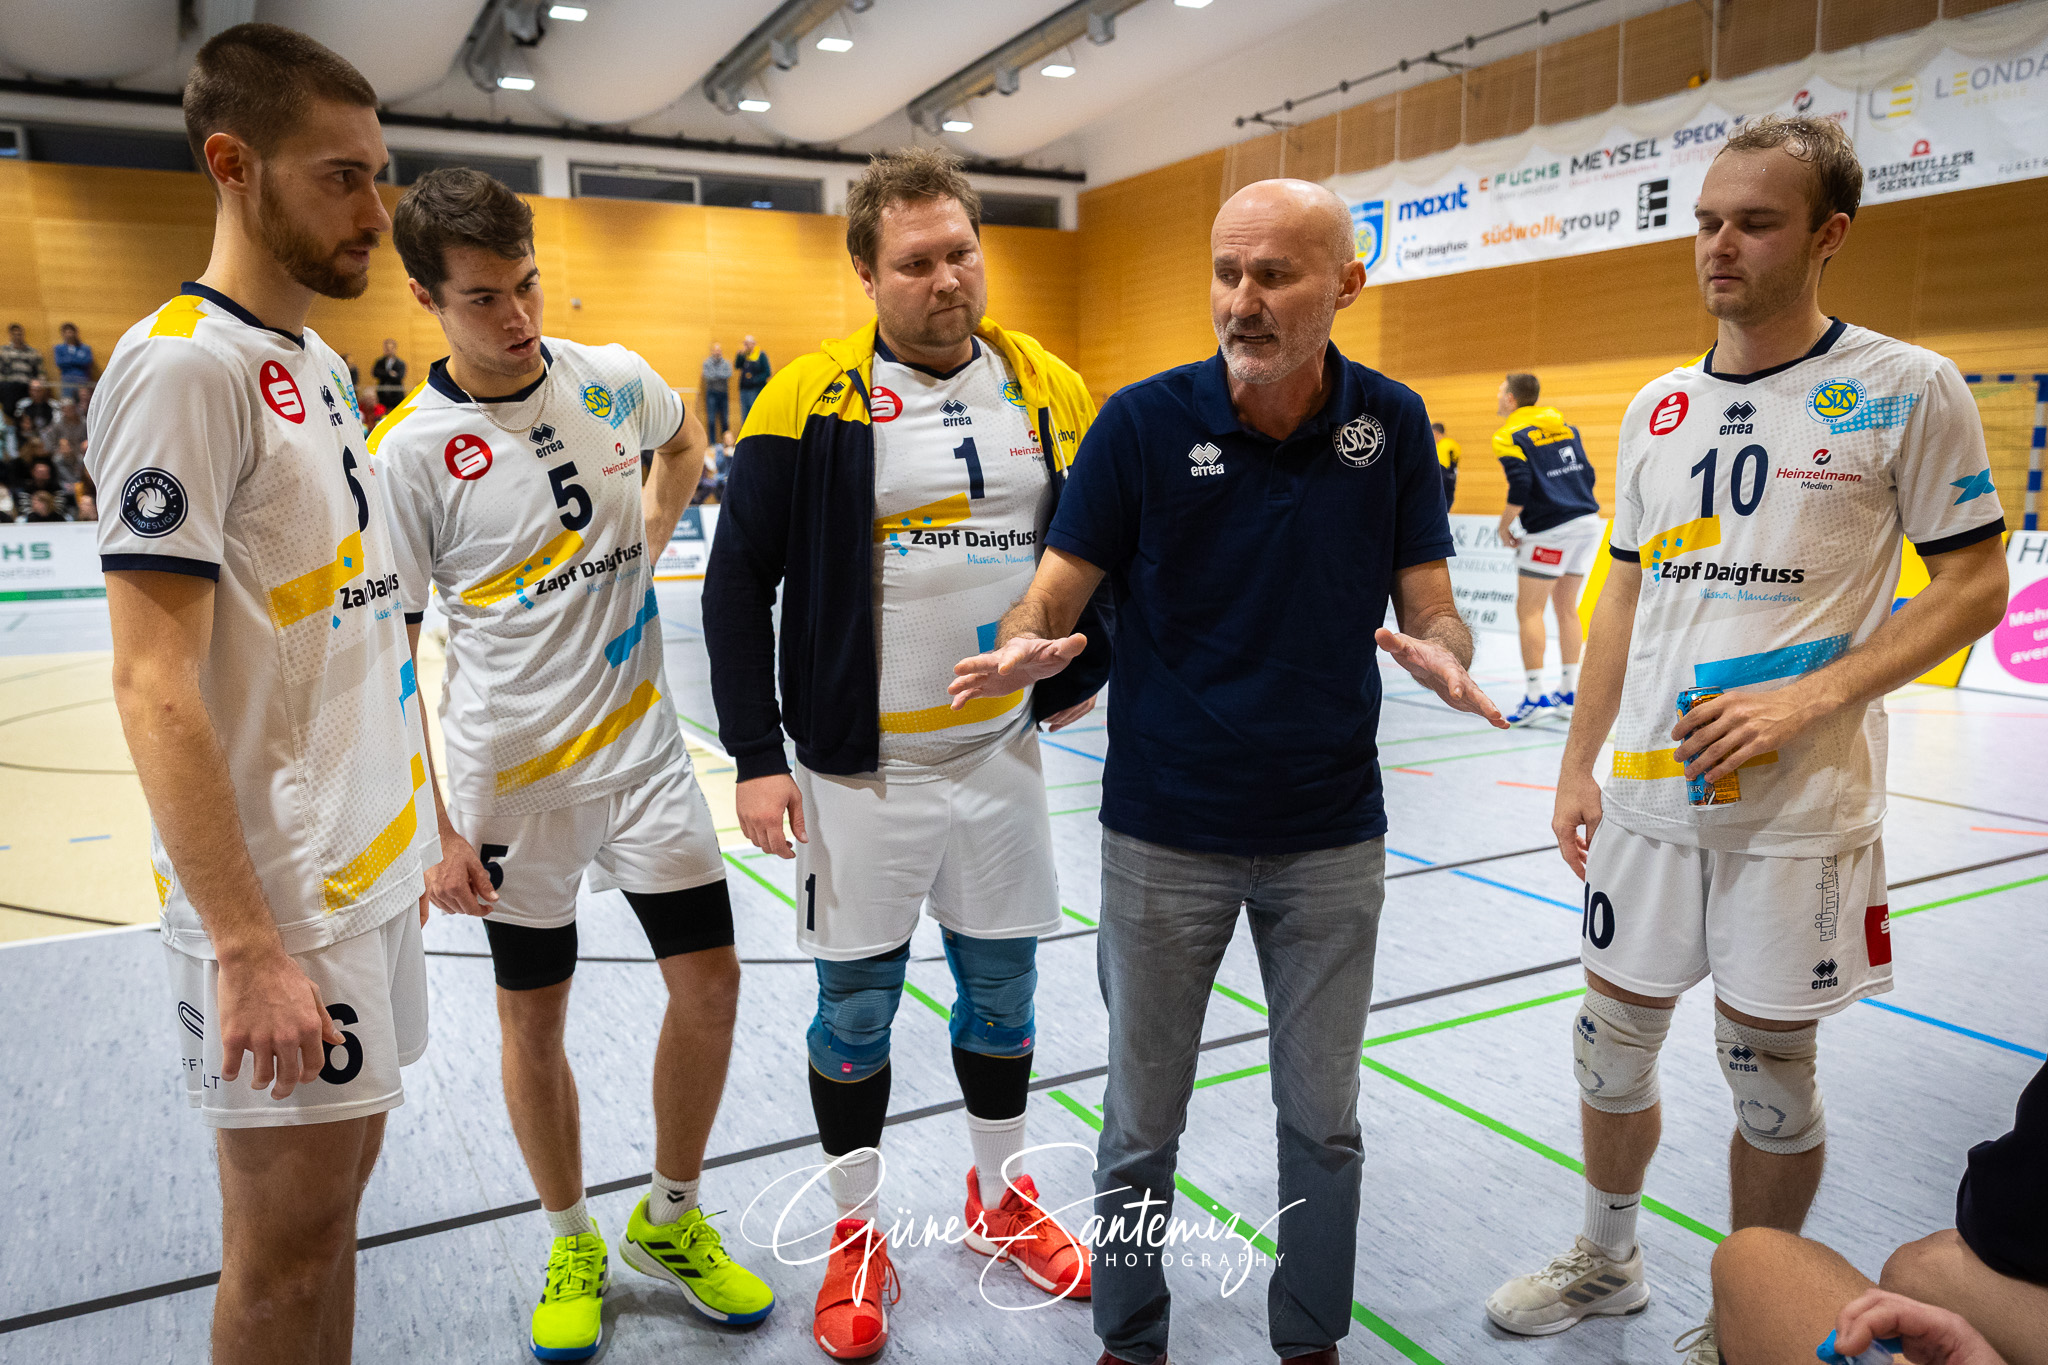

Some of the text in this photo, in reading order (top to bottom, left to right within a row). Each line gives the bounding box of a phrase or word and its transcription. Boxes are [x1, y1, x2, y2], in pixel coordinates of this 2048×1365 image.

[1673, 119, 1727, 150] SPECK
[1570, 137, 1661, 175] MEYSEL
[1495, 162, 1560, 189] FUCHS
[1876, 168, 1960, 195] SERVICES
[1399, 182, 1469, 222] maxit
[943, 415, 972, 427] errea
[1719, 422, 1754, 436] errea
[535, 439, 565, 459] errea
[953, 437, 985, 500] 1
[1191, 463, 1225, 477] errea
[1690, 444, 1769, 519] 10
[1776, 467, 1862, 483] Heinzelmann
[127, 476, 177, 500] VOLLEYBALL
[547, 461, 593, 532] 5
[1800, 481, 1833, 491] Medien
[127, 510, 177, 530] BUNDESLIGA
[909, 529, 1037, 551] Zapf Daigfuss
[535, 566, 578, 595] Zapf
[580, 541, 643, 579] Daigfuss
[1661, 561, 1805, 586] Zapf Daigfuss
[1737, 589, 1805, 603] Mauerstein
[478, 843, 510, 891] 5
[805, 872, 817, 932] 1
[1582, 881, 1616, 950] 10
[1811, 976, 1839, 990] errea
[318, 1003, 364, 1085] 6
[1729, 1061, 1759, 1073] errea
